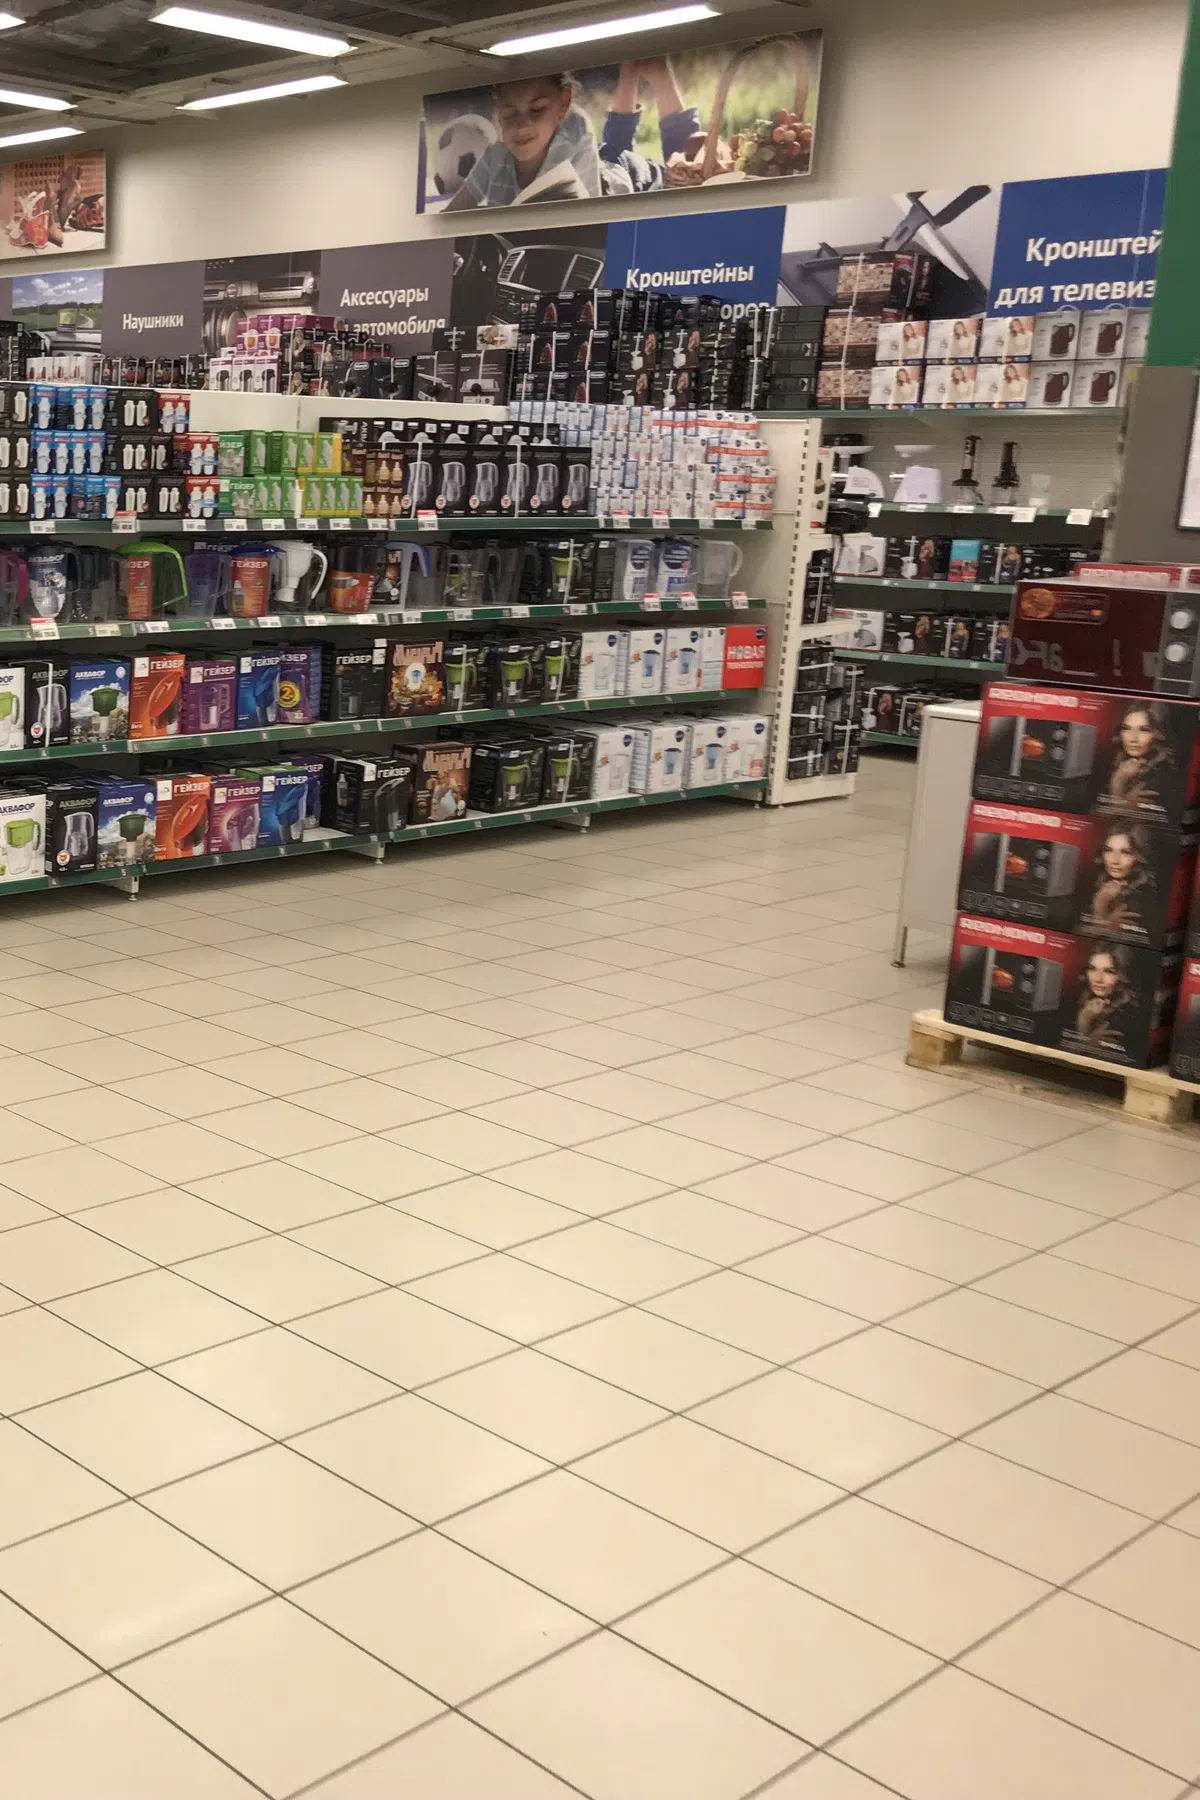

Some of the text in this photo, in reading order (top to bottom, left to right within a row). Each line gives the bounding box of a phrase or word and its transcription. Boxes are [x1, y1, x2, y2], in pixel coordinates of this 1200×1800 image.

[627, 263, 754, 290] Кронштейны
[340, 287, 429, 309] Аксессуары
[994, 286, 1043, 309] для
[123, 313, 184, 333] Наушники
[151, 658, 184, 670] ГЕЙЗЕР
[336, 654, 372, 665] ГЕЙЗЕР
[204, 665, 236, 677] ГЕЙЗЕР
[377, 766, 410, 778] ГЕЙЗЕР
[275, 775, 308, 786] ГЕЙЗЕР
[174, 781, 210, 793] ГЕЙЗЕР
[228, 786, 260, 797] ГЕЙЗЕР
